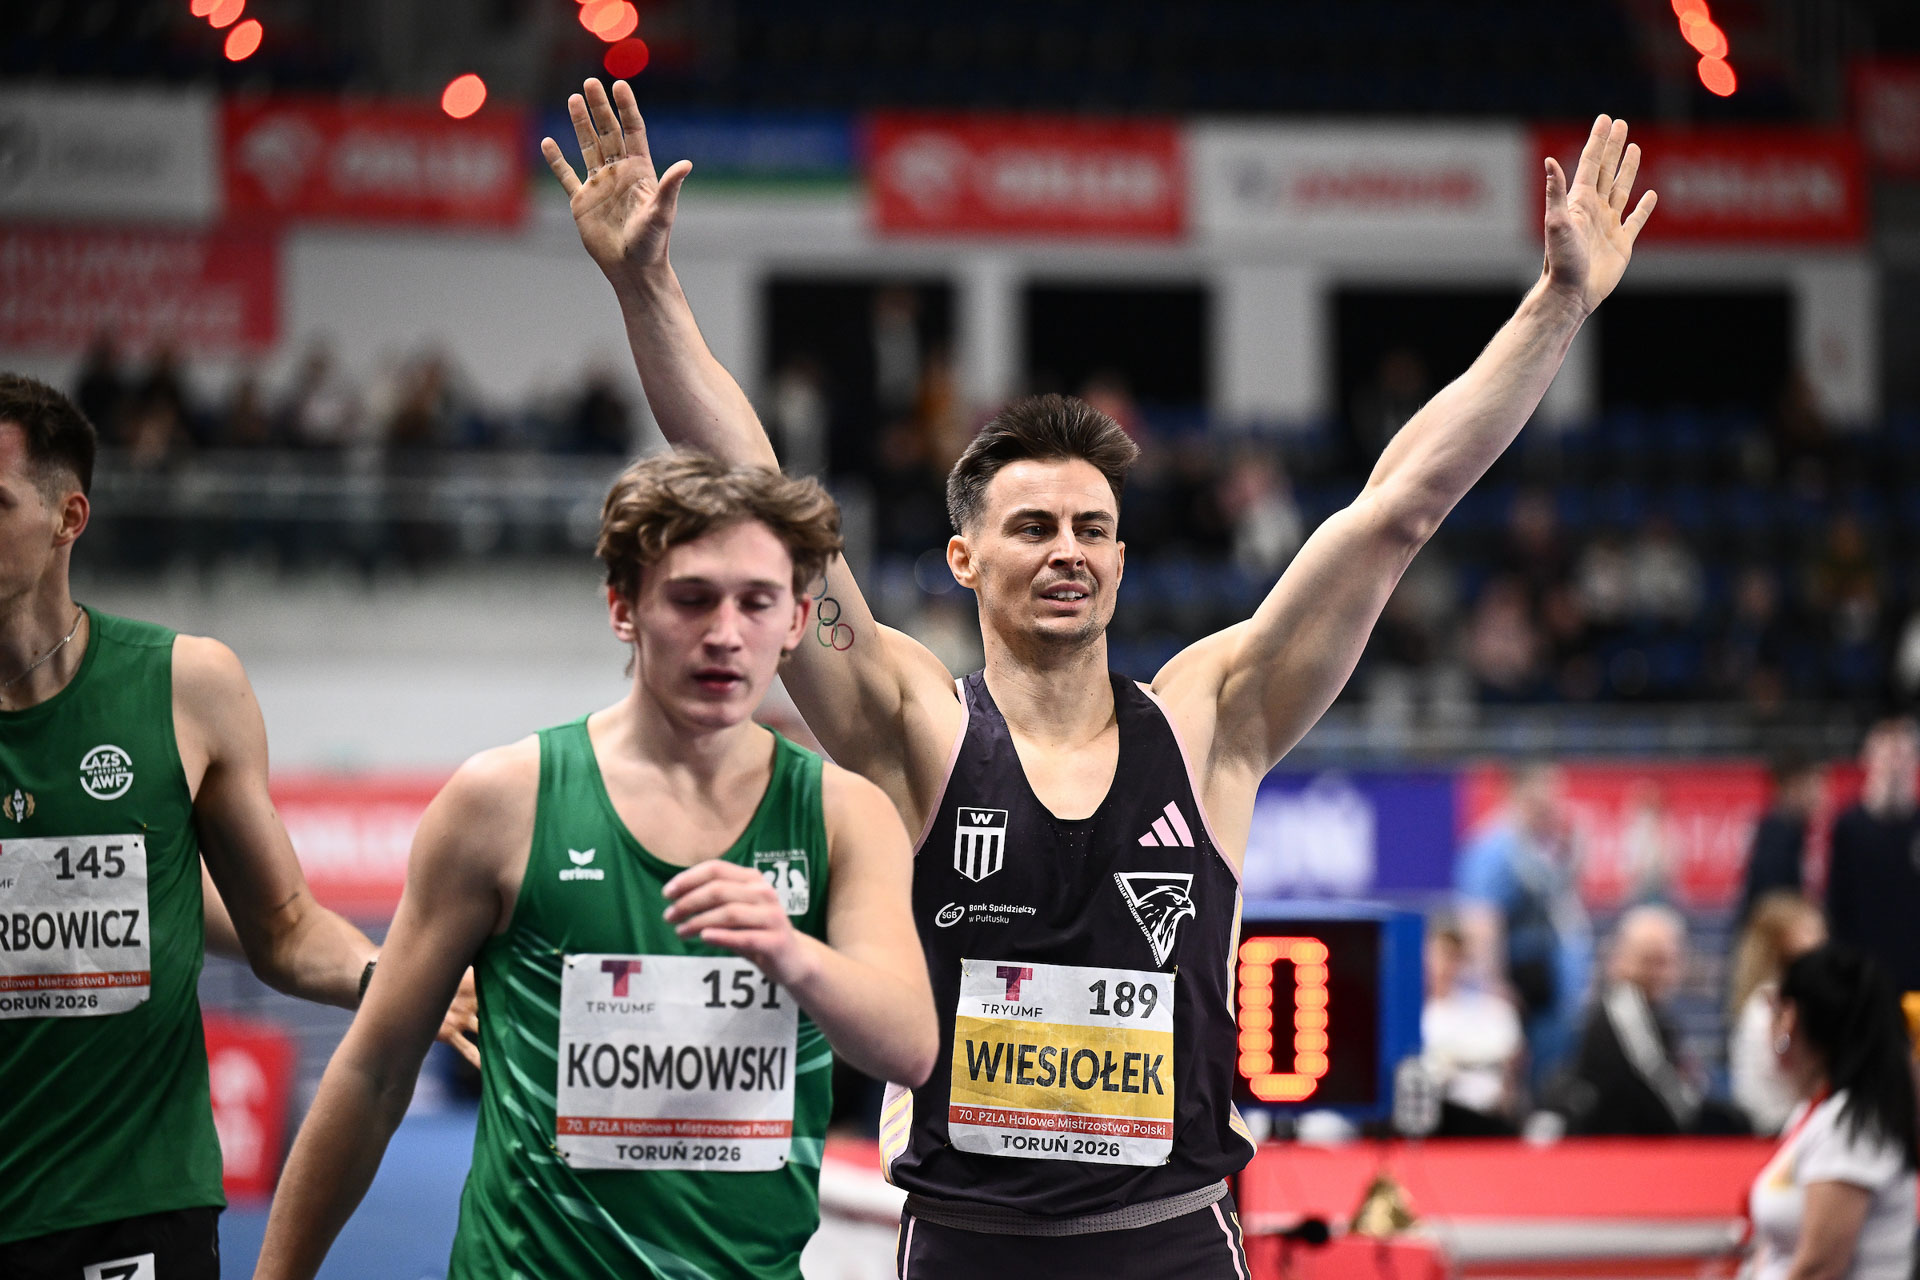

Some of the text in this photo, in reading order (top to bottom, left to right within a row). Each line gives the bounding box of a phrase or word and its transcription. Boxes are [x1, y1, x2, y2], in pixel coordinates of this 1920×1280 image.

[91, 753, 121, 768] AZS
[90, 774, 126, 790] AWF
[970, 812, 994, 825] W
[53, 845, 126, 880] 145
[559, 866, 605, 881] erima
[941, 911, 958, 919] SGB
[969, 903, 988, 912] Bank
[0, 909, 141, 951] RBOWICZ
[38, 975, 105, 988] Mistrzostwa
[108, 973, 142, 985] Polski
[702, 970, 781, 1009] 151
[55, 995, 98, 1009] 2026
[1089, 979, 1158, 1018] 189
[586, 1001, 656, 1014] TRYUMF
[981, 1003, 1043, 1018] TRYUMF
[1238, 936, 1329, 1102] 0
[567, 1043, 787, 1091] KOSMOWSKI
[965, 1039, 1164, 1095] WIESIOŁEK
[566, 1119, 785, 1136] 70. PZLA Halowe Mistrzostwa Polski
[958, 1109, 1166, 1136] 70. PZLA Halowe Mistrzostwa Polski
[616, 1140, 741, 1161] TORUŃ 2026
[1001, 1134, 1121, 1157] TORUŃ 2026
